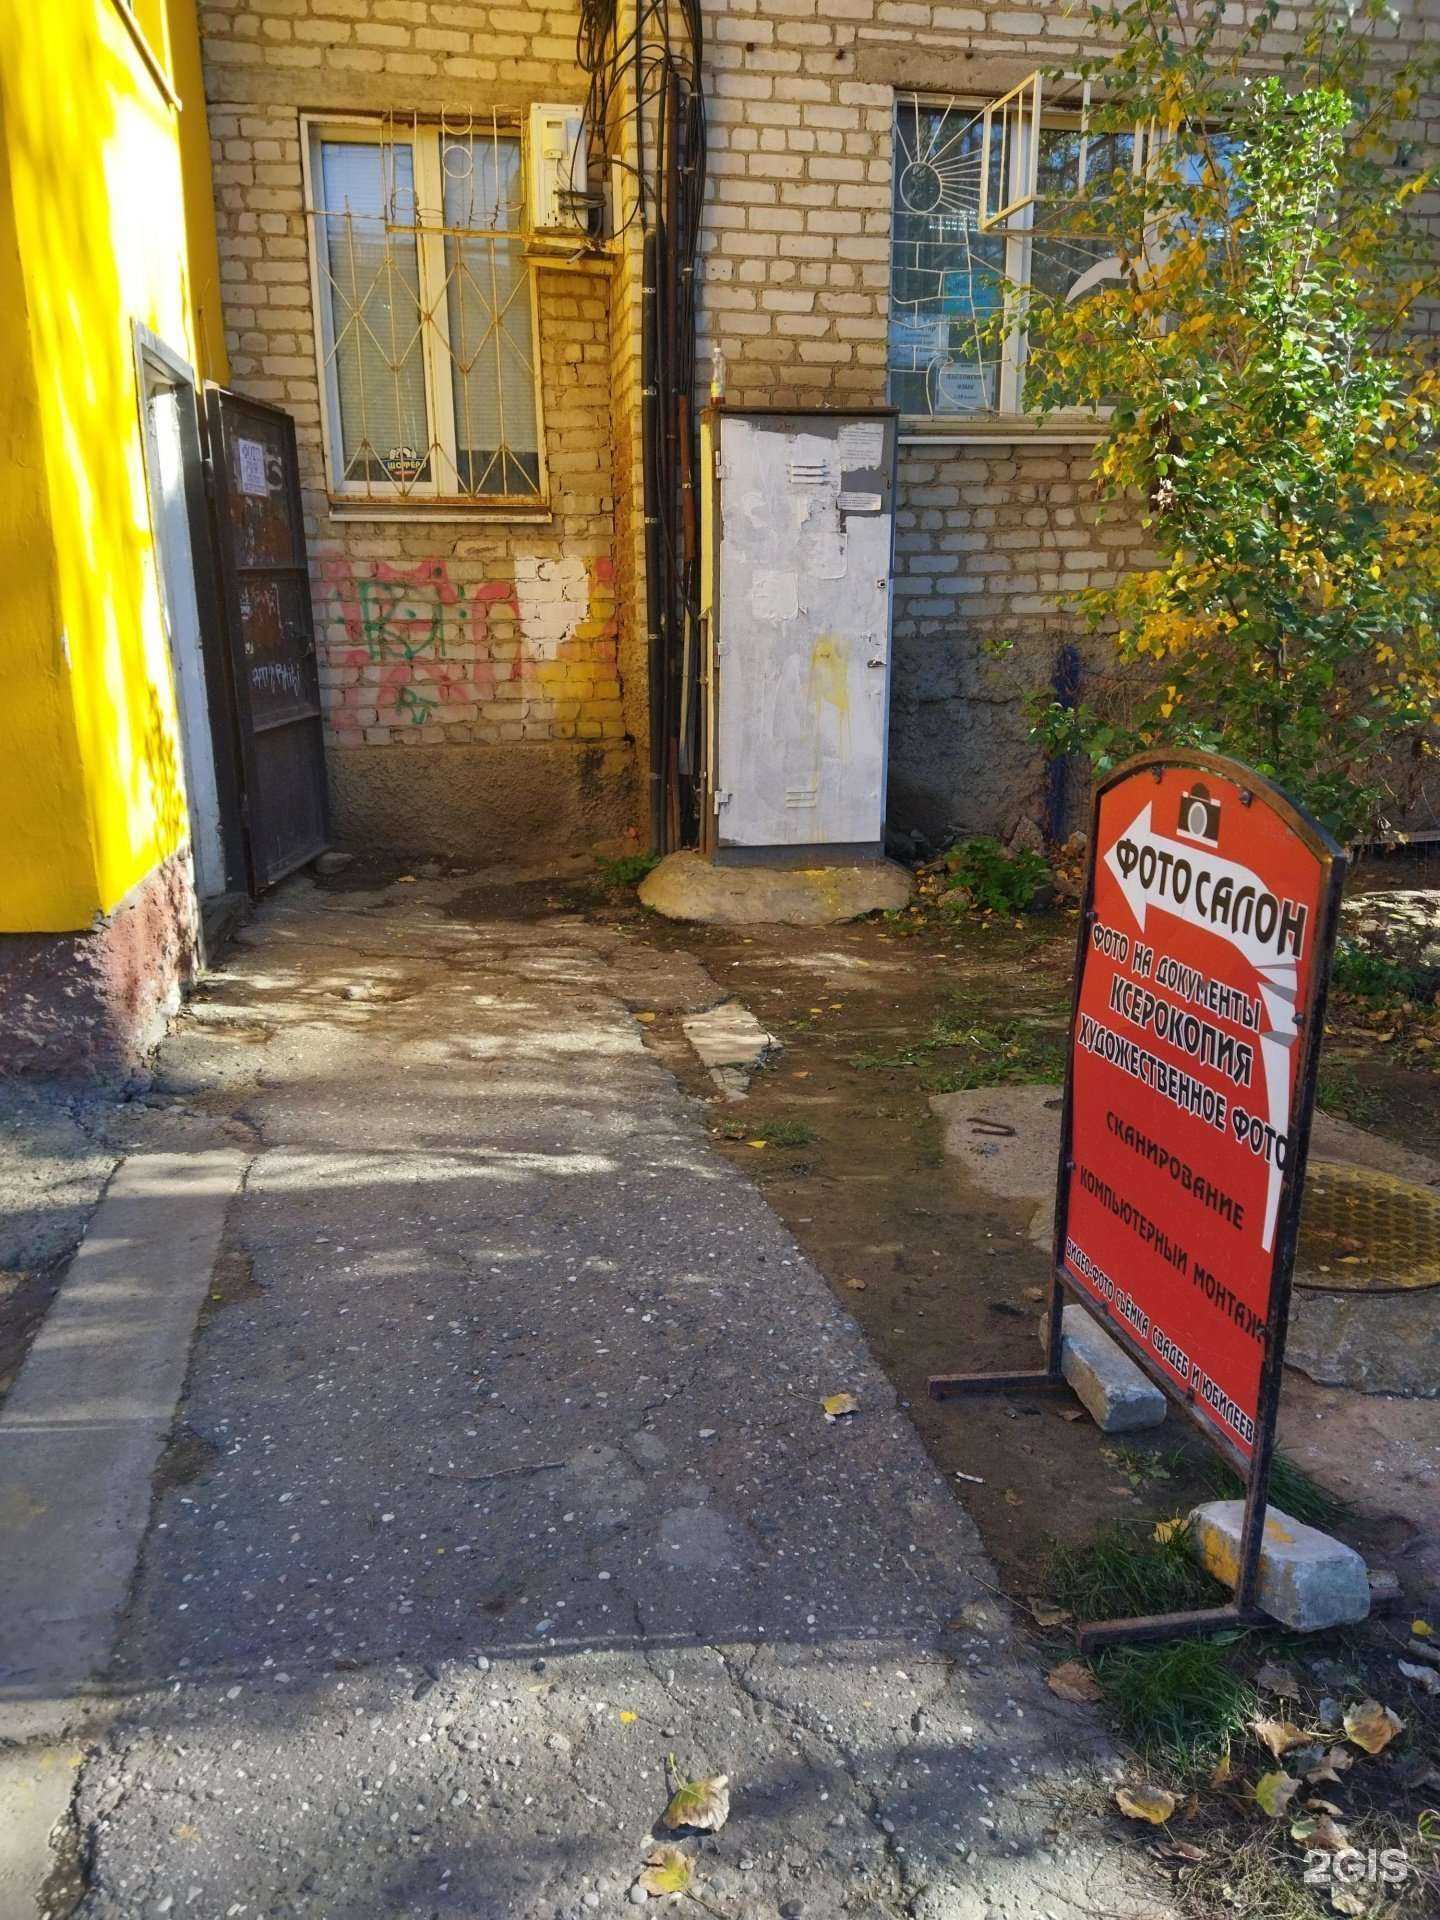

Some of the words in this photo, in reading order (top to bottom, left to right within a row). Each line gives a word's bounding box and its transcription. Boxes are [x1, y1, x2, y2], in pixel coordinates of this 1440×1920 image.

[1116, 838, 1308, 959] ФОТОСАЛОН
[1093, 922, 1129, 964] ФОТО
[1132, 941, 1153, 979] НА
[1155, 955, 1262, 1034] ДОКУМЕНТЫ
[1109, 973, 1254, 1088] КСЕРОКОПИЯ
[1077, 1013, 1227, 1133] ХУДОЖЕСТВЕННОЕ
[1232, 1105, 1288, 1172] ФОТО
[1106, 1111, 1245, 1231] СКАНИРОВАНИЕ
[1066, 1236, 1115, 1302] ВИДЕО-ФОТО
[1152, 1325, 1189, 1380] СВАДЕБ
[1190, 1363, 1201, 1392] И
[1201, 1372, 1254, 1445] ЮБИЛЕЕВ
